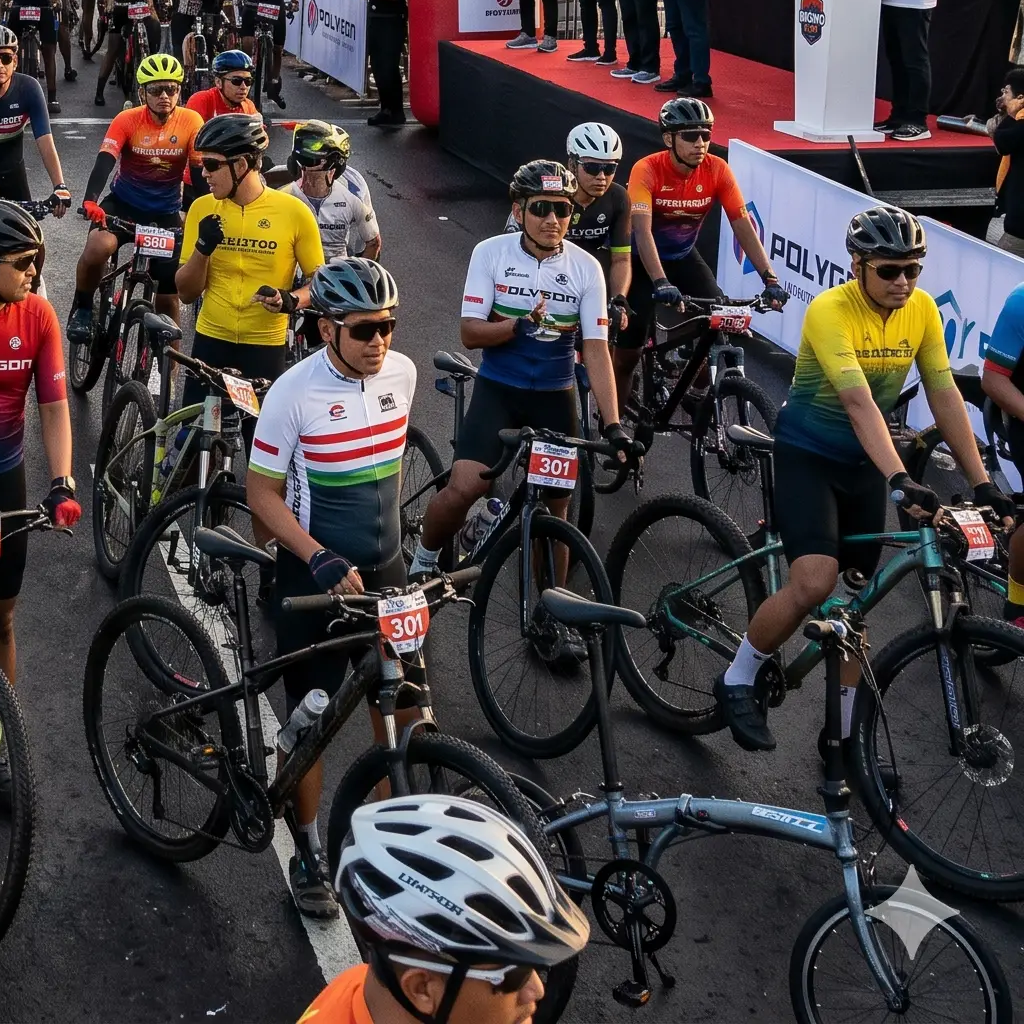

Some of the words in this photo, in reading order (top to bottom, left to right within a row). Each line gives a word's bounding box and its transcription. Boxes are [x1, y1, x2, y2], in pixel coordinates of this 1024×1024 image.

[770, 232, 857, 290] POLYG
[539, 457, 570, 476] 301
[390, 612, 424, 639] 301
